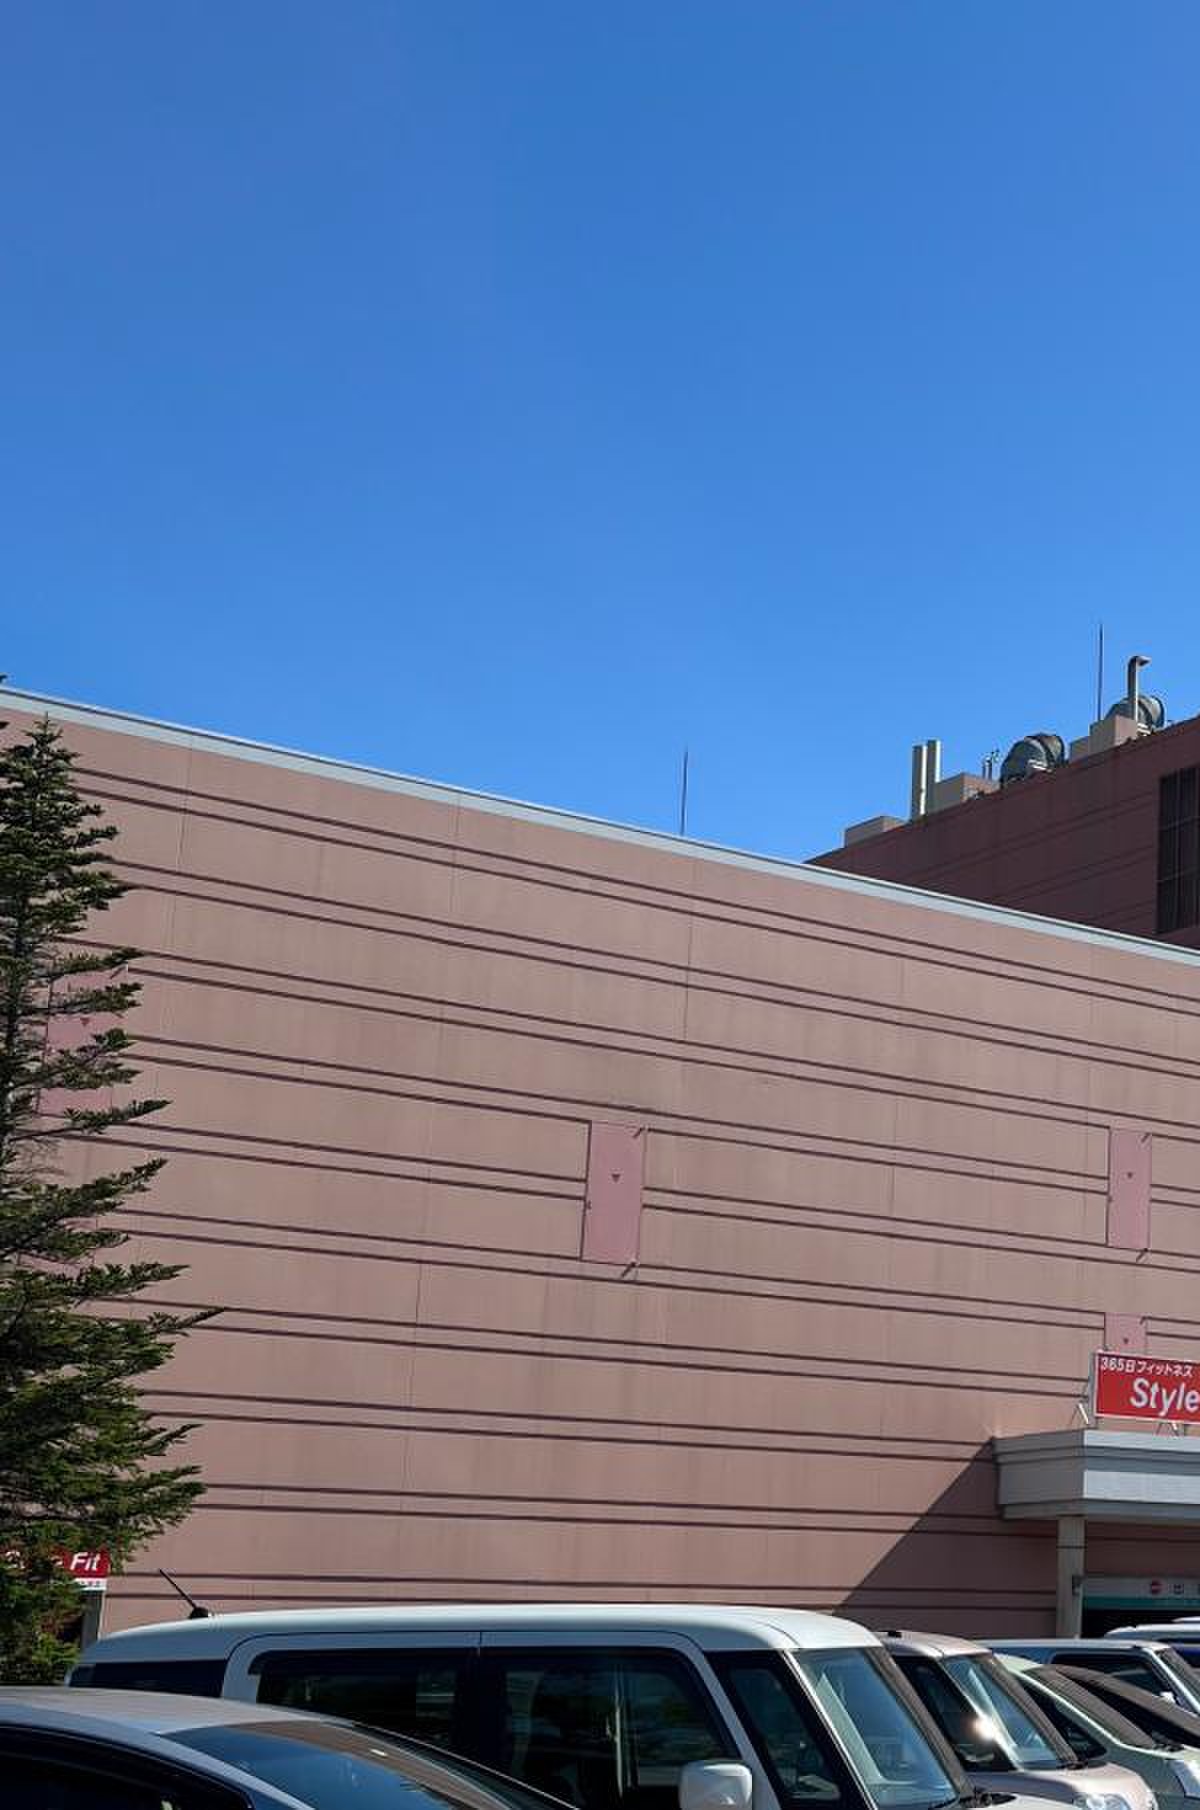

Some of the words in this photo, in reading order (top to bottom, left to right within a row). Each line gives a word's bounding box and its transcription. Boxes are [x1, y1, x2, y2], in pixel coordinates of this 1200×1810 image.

[1100, 1356, 1194, 1378] 365日フィットネス
[1129, 1377, 1200, 1417] Style
[69, 1551, 101, 1571] Fit
